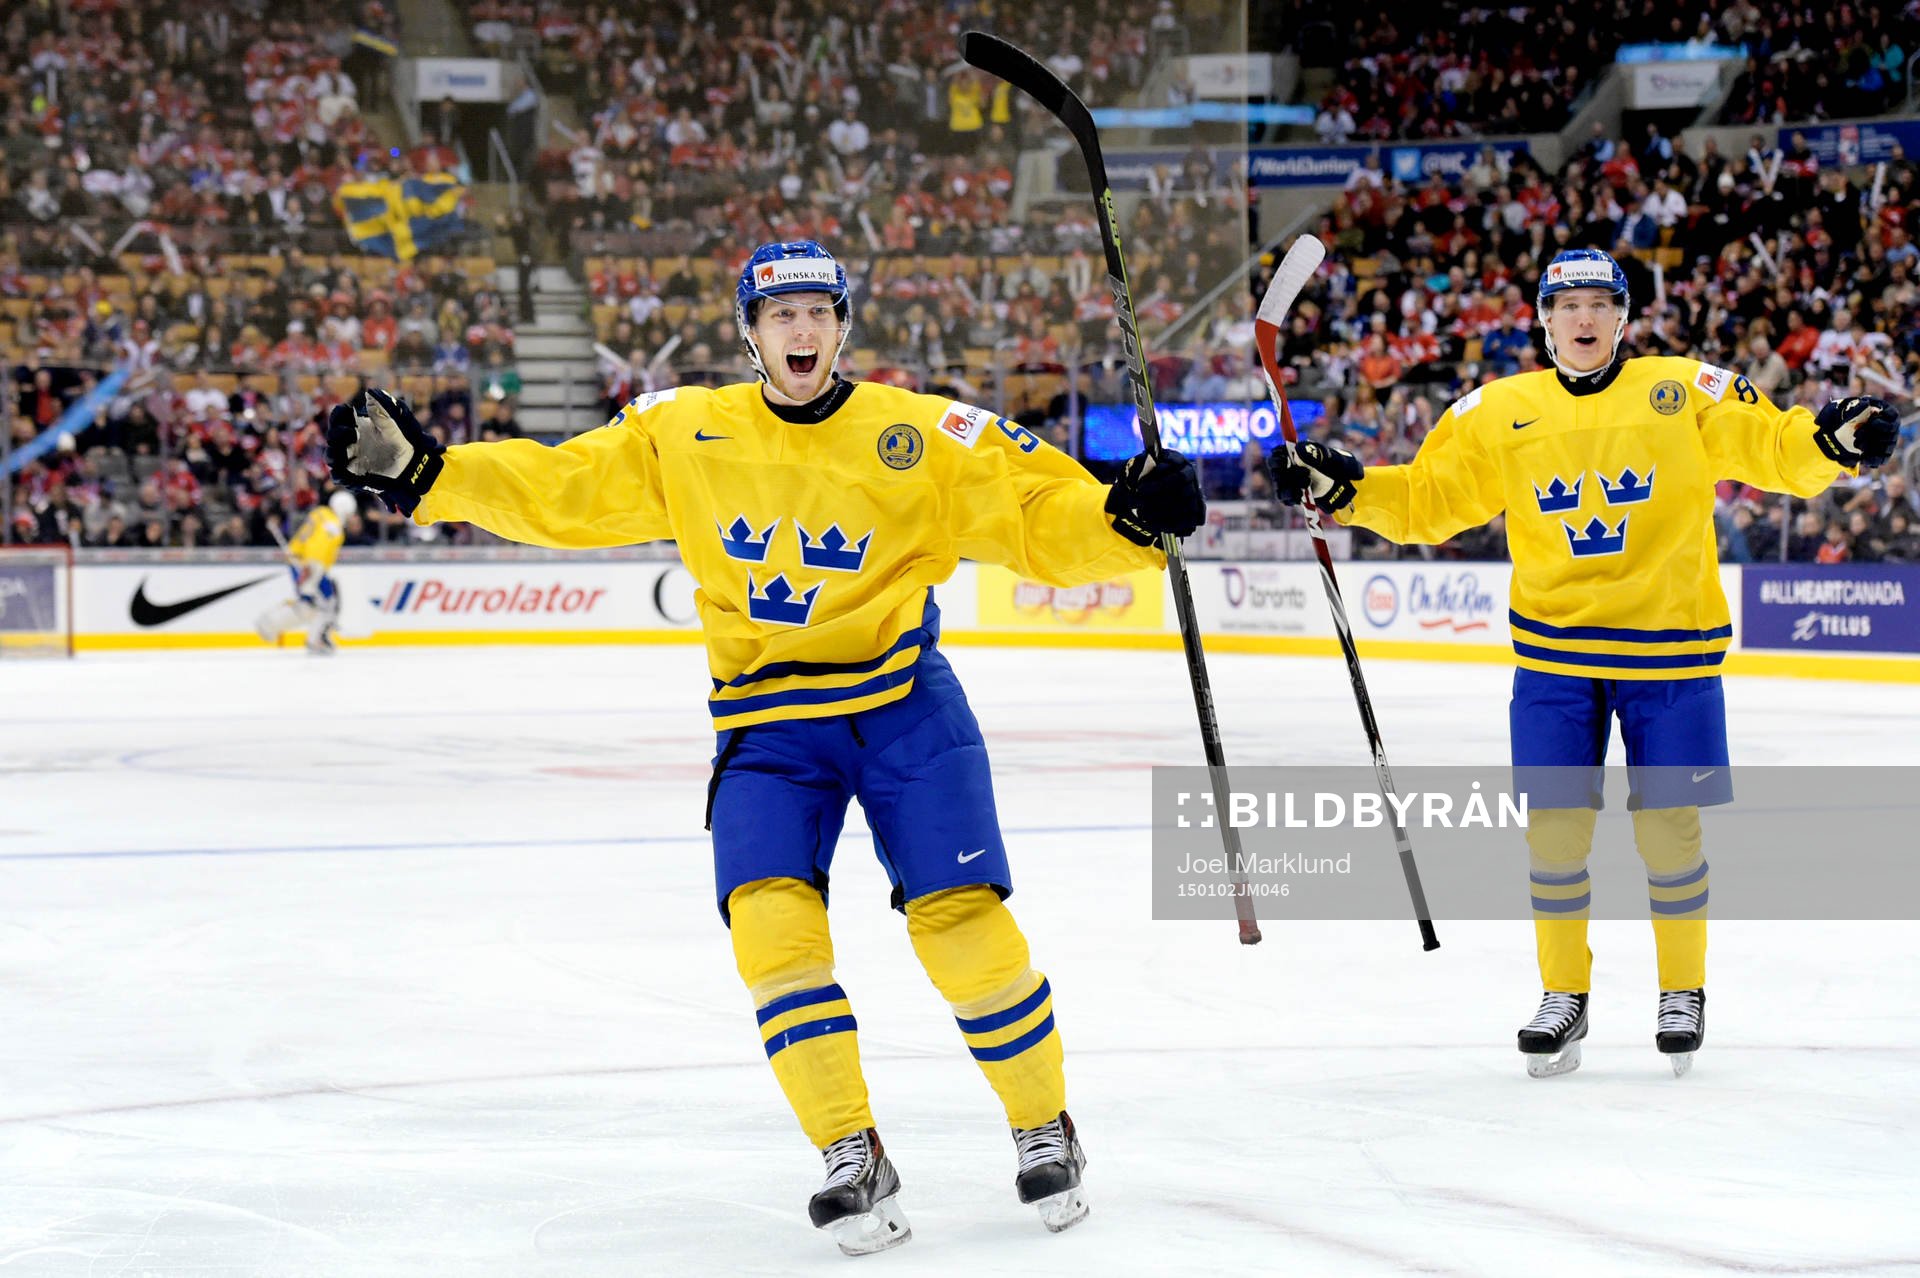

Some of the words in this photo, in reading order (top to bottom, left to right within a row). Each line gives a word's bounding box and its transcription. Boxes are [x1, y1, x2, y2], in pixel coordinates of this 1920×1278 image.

[778, 271, 816, 282] SVENSKA
[818, 272, 835, 281] SPEL
[1563, 271, 1595, 279] SVENSKA
[1596, 271, 1611, 279] SPEL
[1109, 273, 1152, 426] CCM
[1734, 374, 1758, 405] 8
[995, 417, 1040, 453] 5
[410, 453, 430, 485] CCM
[1328, 485, 1345, 505] CCM
[1120, 518, 1152, 537] CCM
[412, 579, 605, 614] Purolator
[1760, 579, 1905, 606] #ALLHEARTCANADA
[1820, 614, 1872, 637] TELUS
